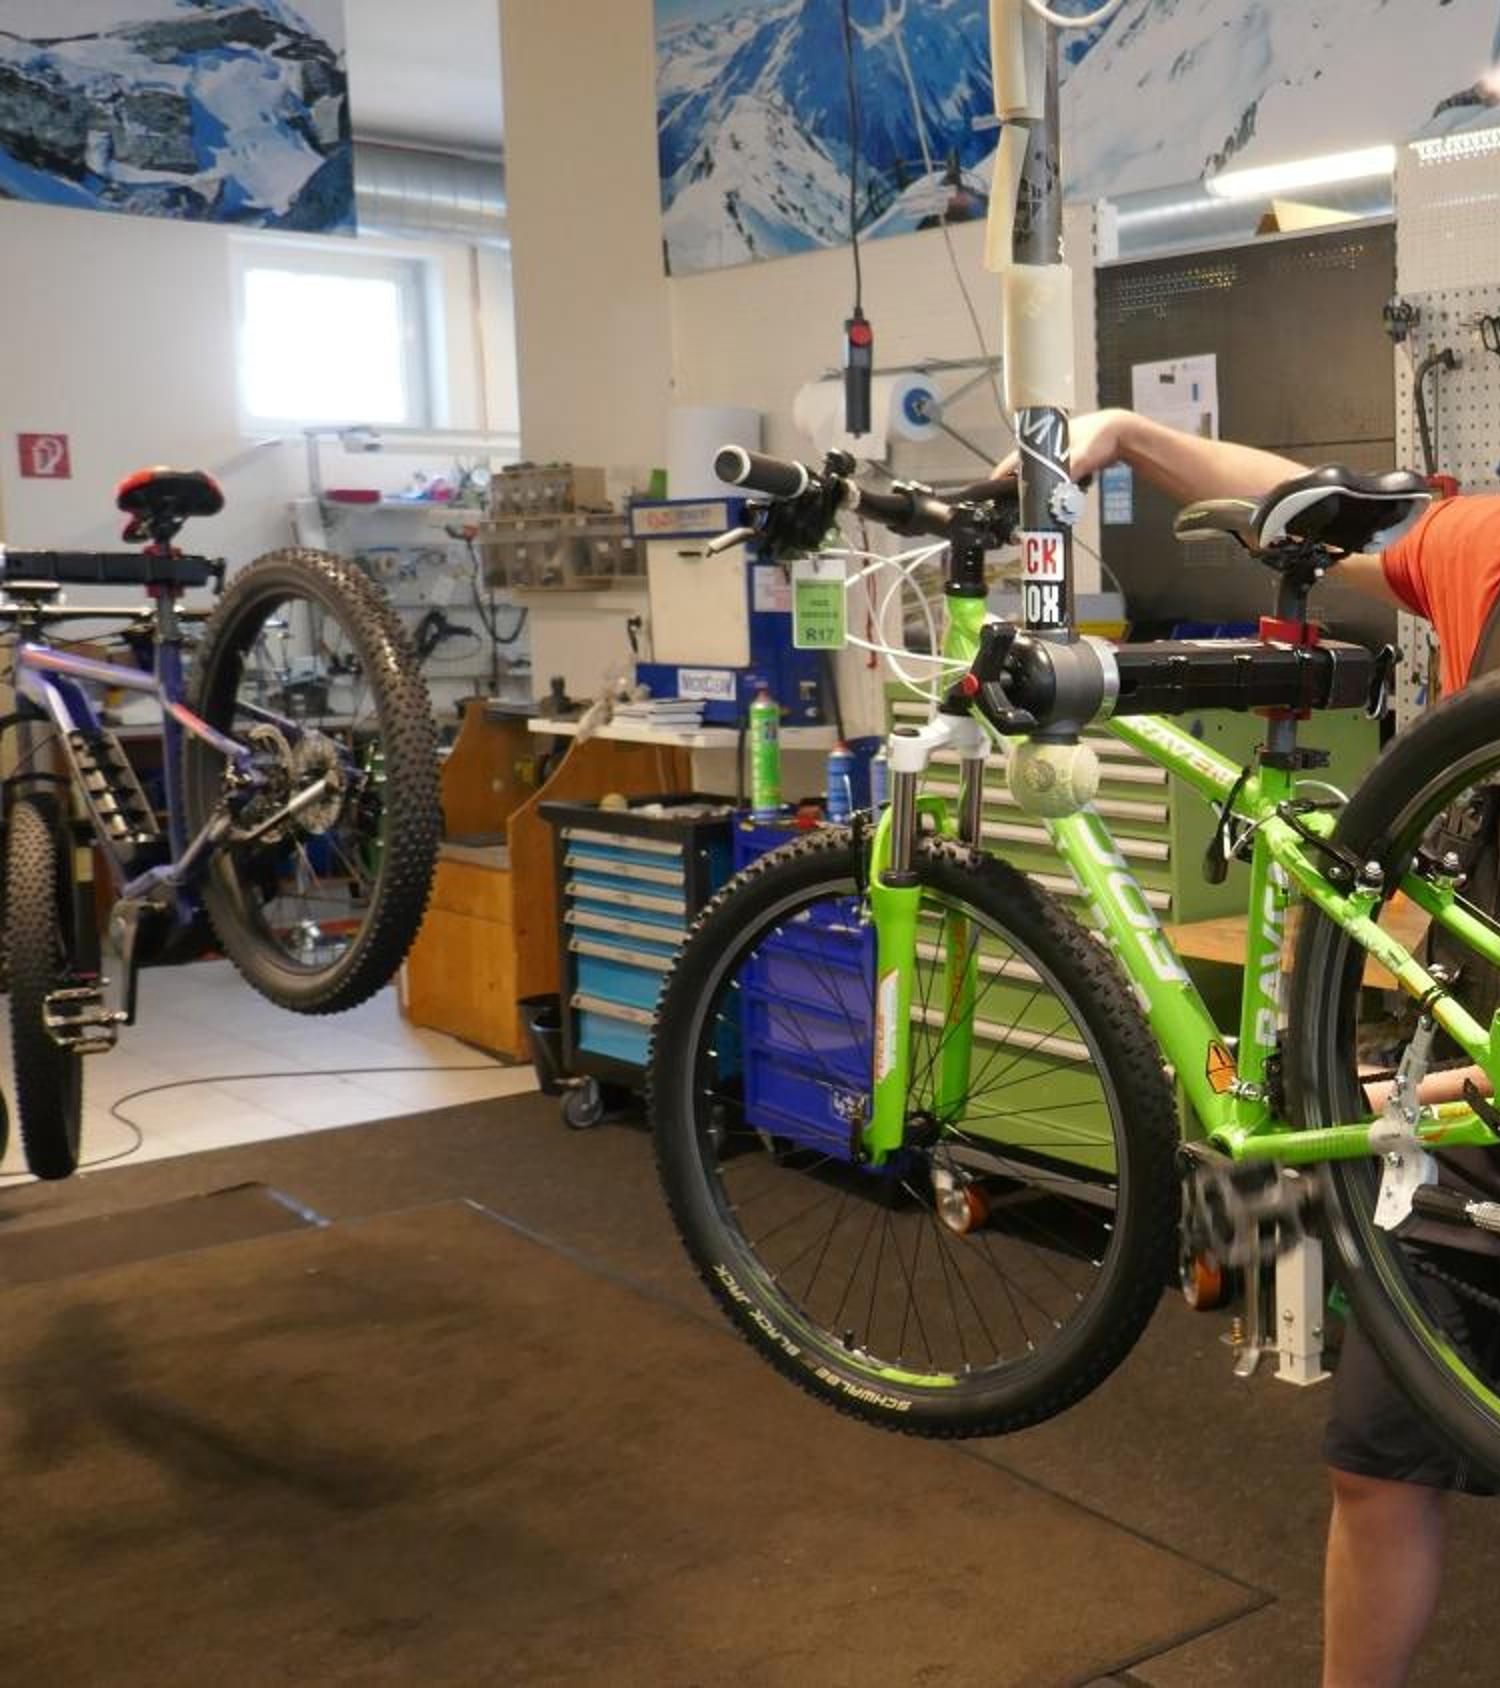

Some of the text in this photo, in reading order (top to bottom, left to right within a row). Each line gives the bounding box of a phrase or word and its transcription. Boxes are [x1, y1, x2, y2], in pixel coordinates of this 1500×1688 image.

[1025, 538, 1057, 574] CK
[1025, 585, 1060, 624] OX
[806, 627, 835, 641] R17
[712, 1264, 913, 1412] SCHWALBE BLACK JACK
